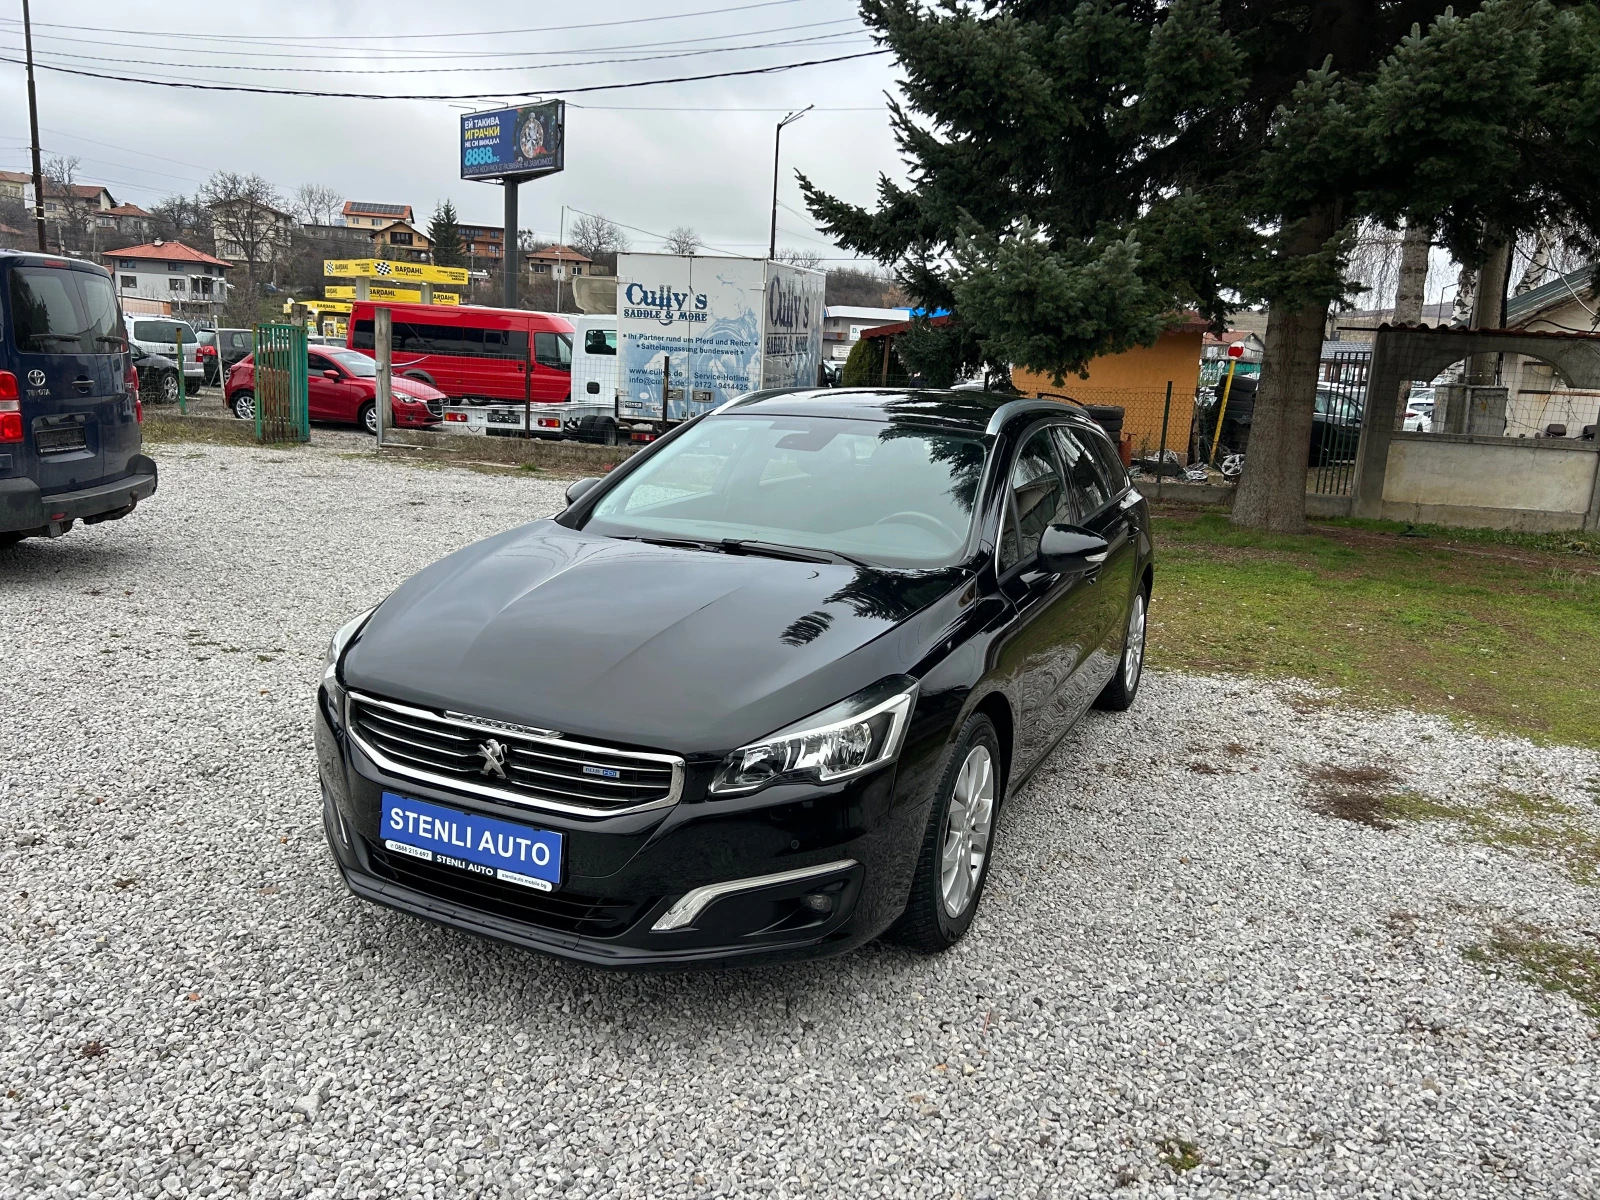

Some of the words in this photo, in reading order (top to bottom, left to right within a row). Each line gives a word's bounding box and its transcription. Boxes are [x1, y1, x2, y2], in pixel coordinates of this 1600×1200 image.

[465, 119, 474, 129] ЕЙ
[474, 116, 500, 127] ТАКИВА
[465, 126, 500, 140] ИГРАЧКИ
[479, 138, 500, 146] ВИЖДАЛ
[395, 265, 423, 276] BARDAHL
[433, 293, 455, 302] ARDAHL
[624, 309, 661, 318] SADDLE
[678, 311, 708, 321] MORE
[696, 337, 714, 345] Pferd
[641, 343, 698, 354] Sattelanpassung
[699, 347, 739, 356] bundesweit
[694, 371, 749, 381] Service-Hotline
[26, 388, 51, 396] TOYOTA
[718, 382, 749, 391] 9414425
[389, 807, 472, 849] STENLI
[477, 830, 550, 866] AUTO
[408, 847, 419, 855] 215
[419, 851, 430, 859] 697
[436, 854, 466, 869] STENLI
[467, 863, 494, 876] AUTO
